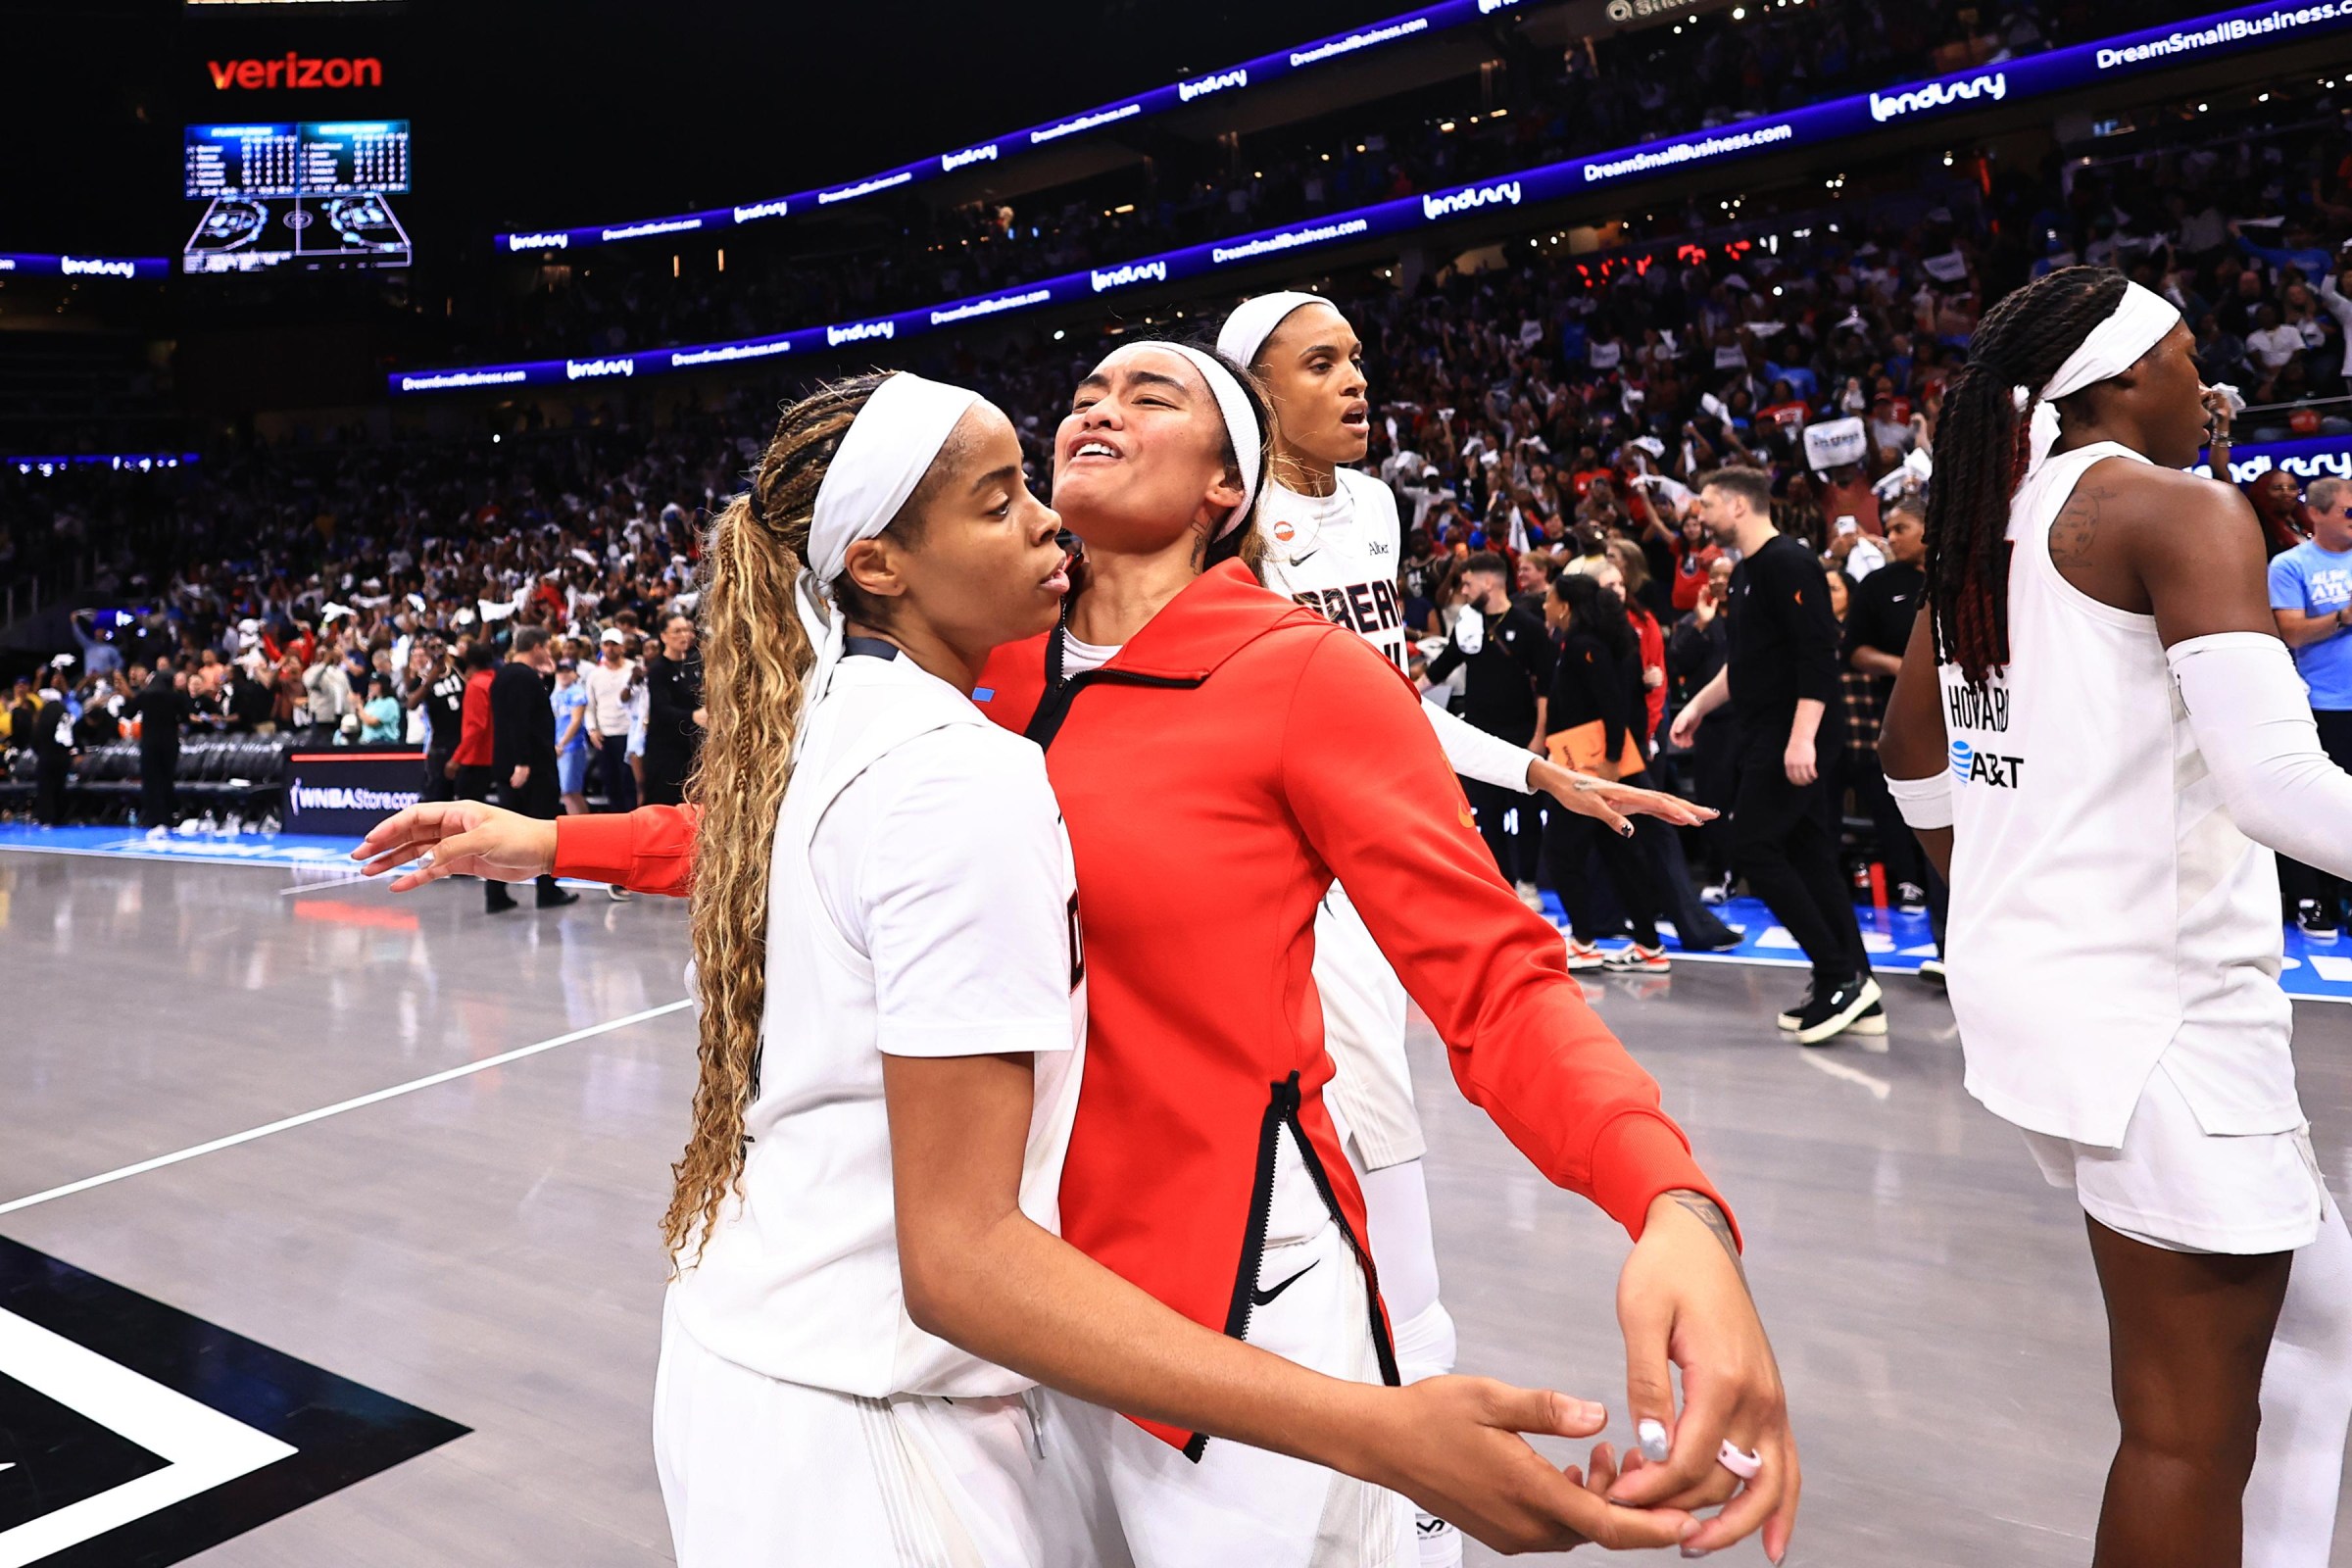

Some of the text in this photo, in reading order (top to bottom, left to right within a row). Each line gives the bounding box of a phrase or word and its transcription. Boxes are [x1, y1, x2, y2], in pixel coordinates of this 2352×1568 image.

[208, 52, 382, 89] verizon
[1869, 73, 2006, 122] lendistry
[1584, 124, 1792, 182] DreamSmallBusiness.com
[1212, 219, 1368, 264] DreamSmallBusiness.com
